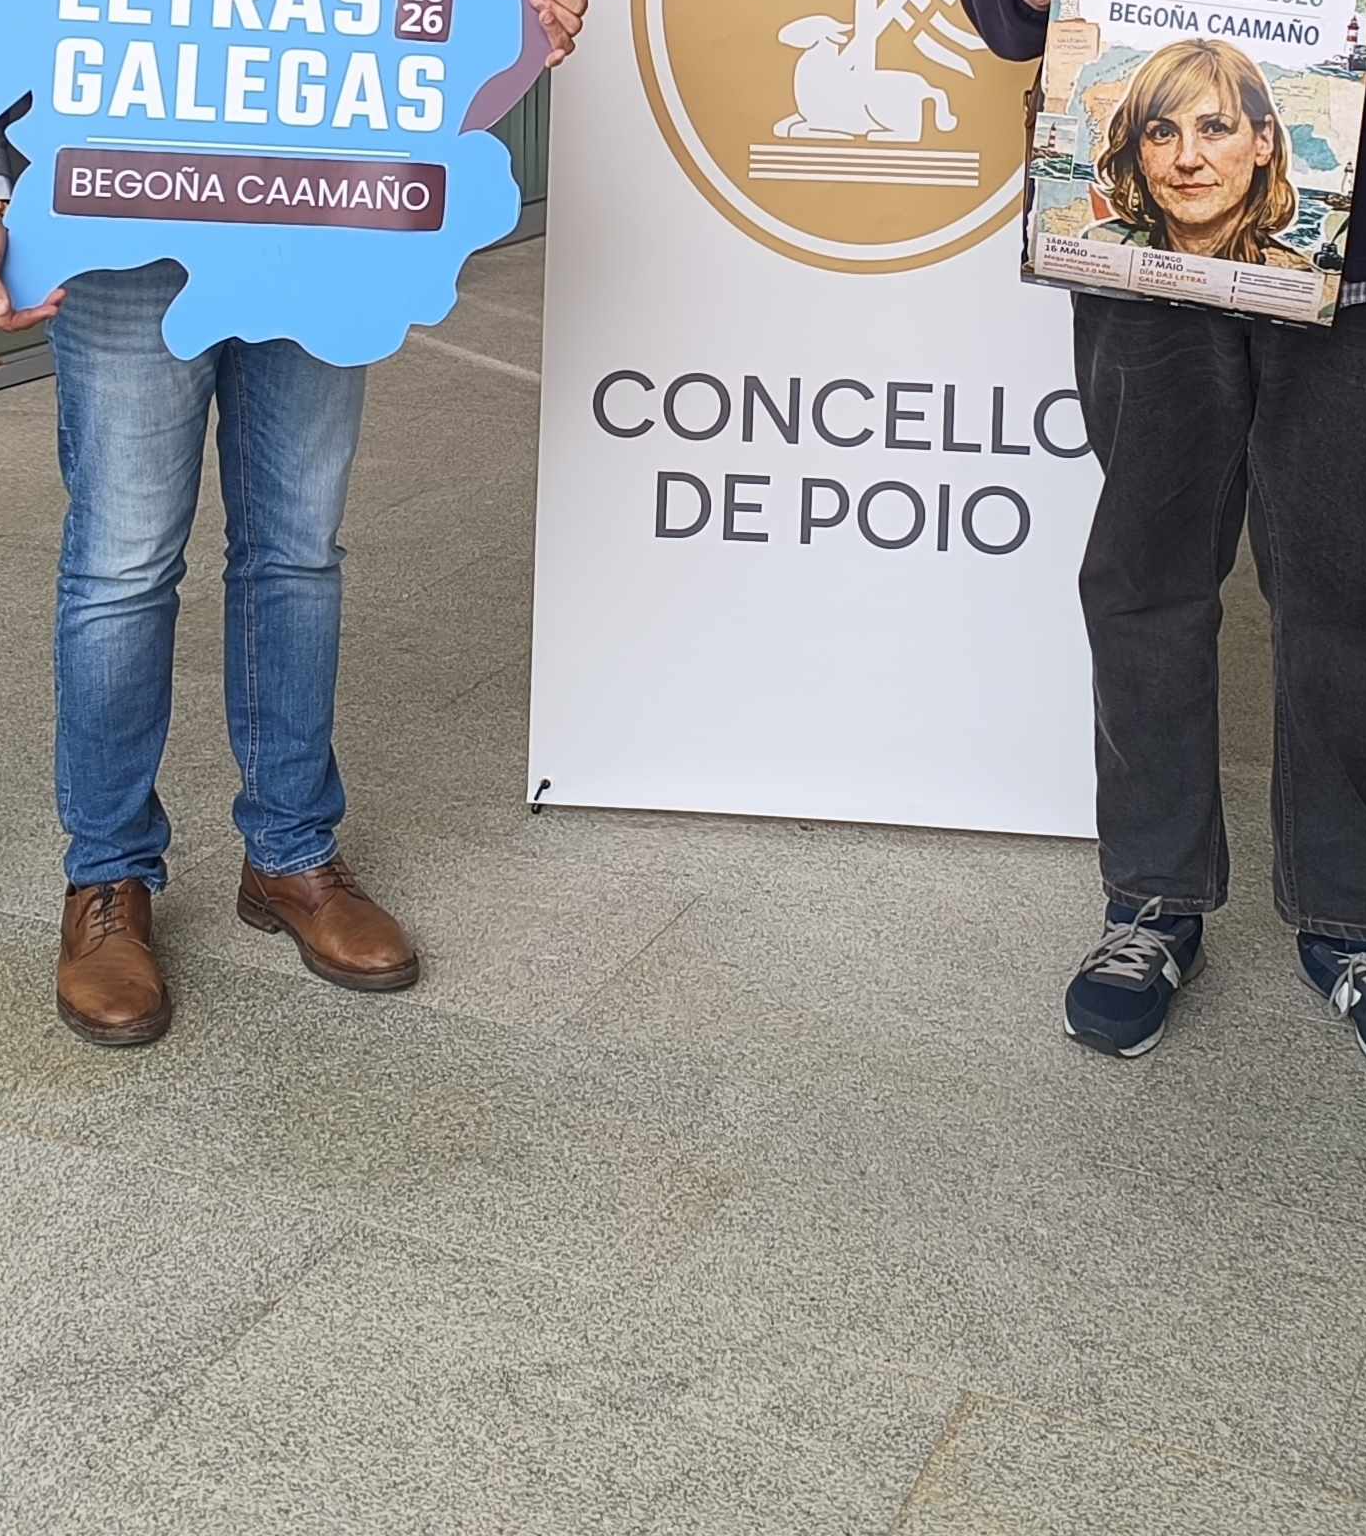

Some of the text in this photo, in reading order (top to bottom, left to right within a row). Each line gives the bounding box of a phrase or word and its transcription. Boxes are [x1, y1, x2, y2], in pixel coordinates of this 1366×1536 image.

[398, 4, 444, 35] 26
[1108, 1, 1320, 46] BEGOÑA CAAMAÑO
[51, 36, 447, 133] GALEGAS
[69, 166, 431, 212] BEGOÑA CAAMAÑO
[1044, 244, 1057, 253] 16
[1059, 246, 1088, 258] MAIO
[1140, 258, 1153, 267] 17
[1154, 261, 1184, 272] MAIO
[1142, 251, 1182, 264] DOMINGO
[1155, 270, 1174, 280] DAS
[1174, 273, 1208, 286] LETRAS
[592, 369, 1094, 460] CONCELLO
[653, 470, 1032, 556] DE POIO
